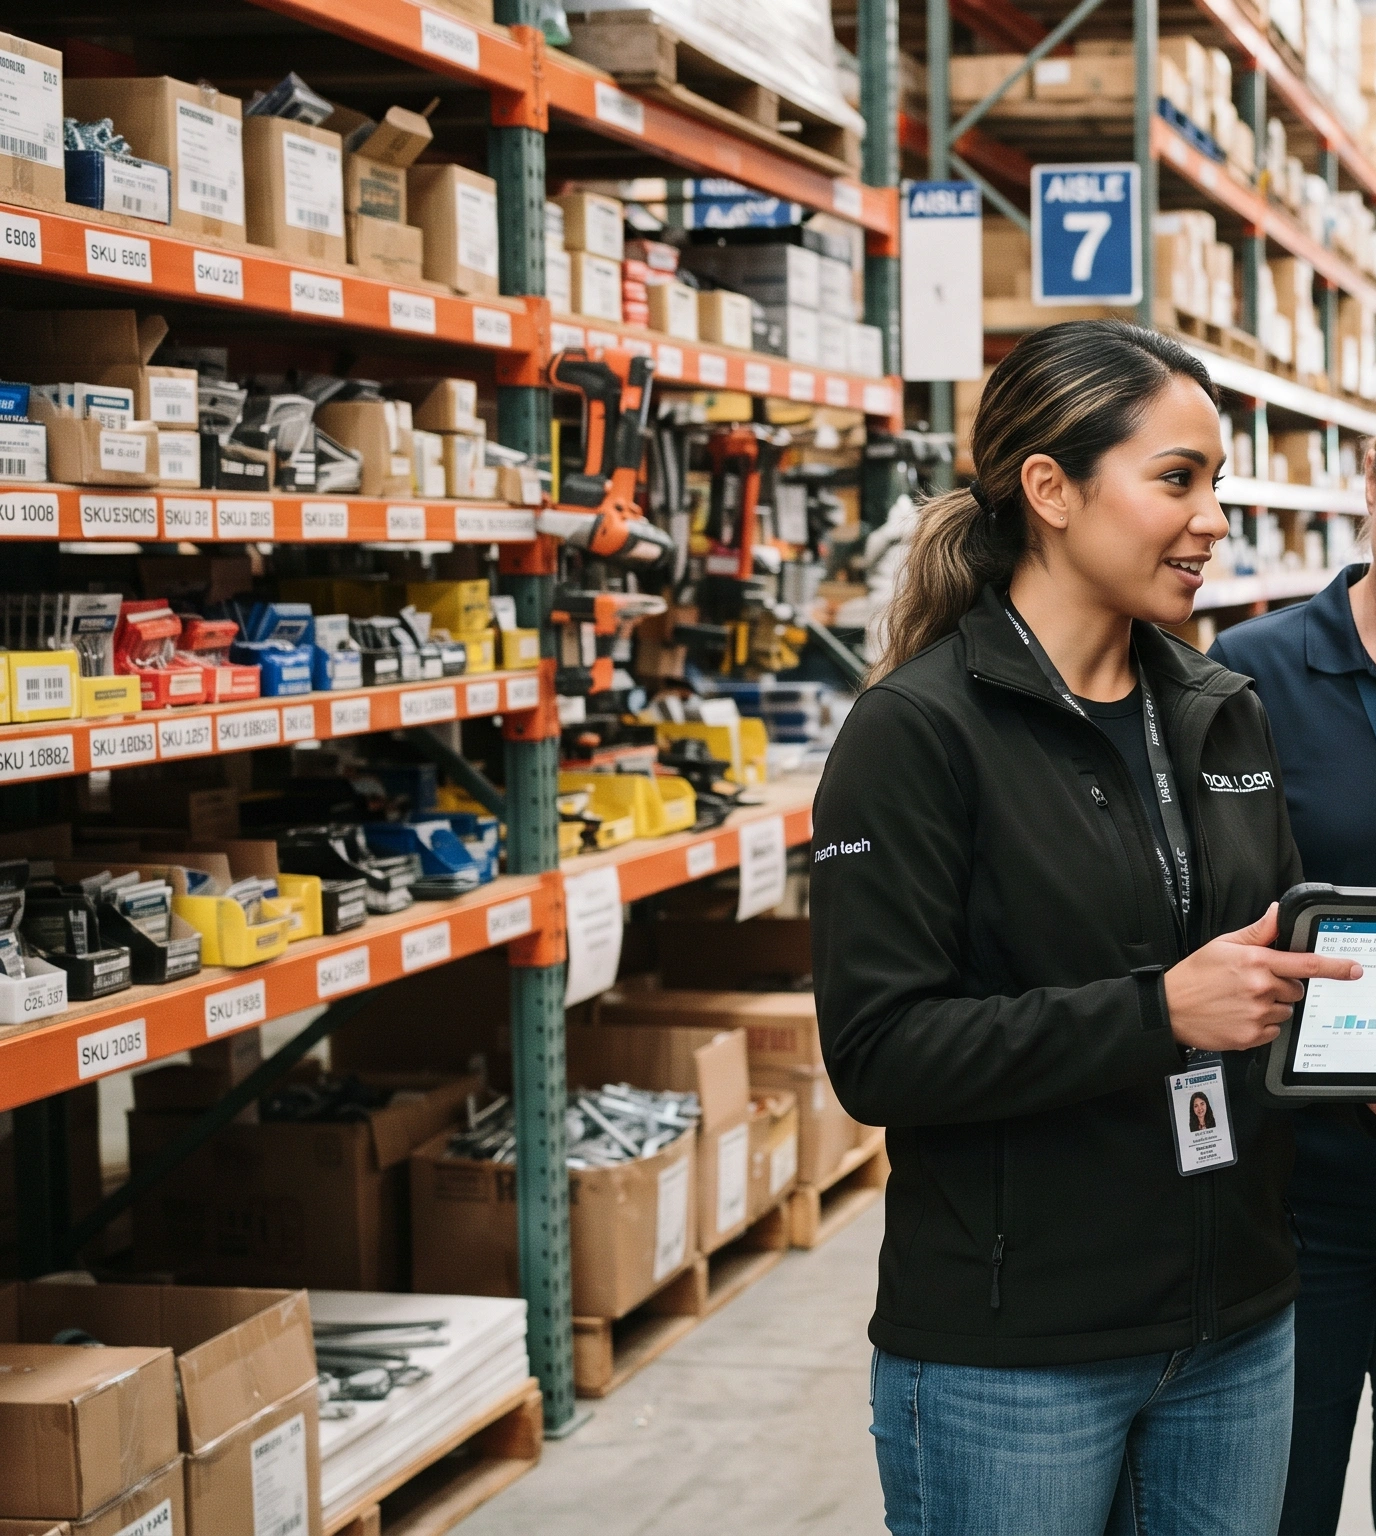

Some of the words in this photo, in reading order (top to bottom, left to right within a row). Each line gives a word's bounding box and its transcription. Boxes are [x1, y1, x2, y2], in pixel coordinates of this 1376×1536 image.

[1044, 174, 1126, 203] AISLE
[911, 189, 975, 215] AISLE
[91, 244, 117, 263] SKU
[1063, 211, 1112, 281] 7
[197, 264, 220, 281] SKU
[21, 504, 54, 521] 1008
[161, 730, 182, 748] SKU
[219, 723, 240, 740] SKU
[29, 746, 70, 768] 16882
[93, 739, 116, 757] SKU
[840, 838, 871, 854] tech
[209, 1001, 233, 1023] SKU
[82, 1042, 109, 1066] SKU
